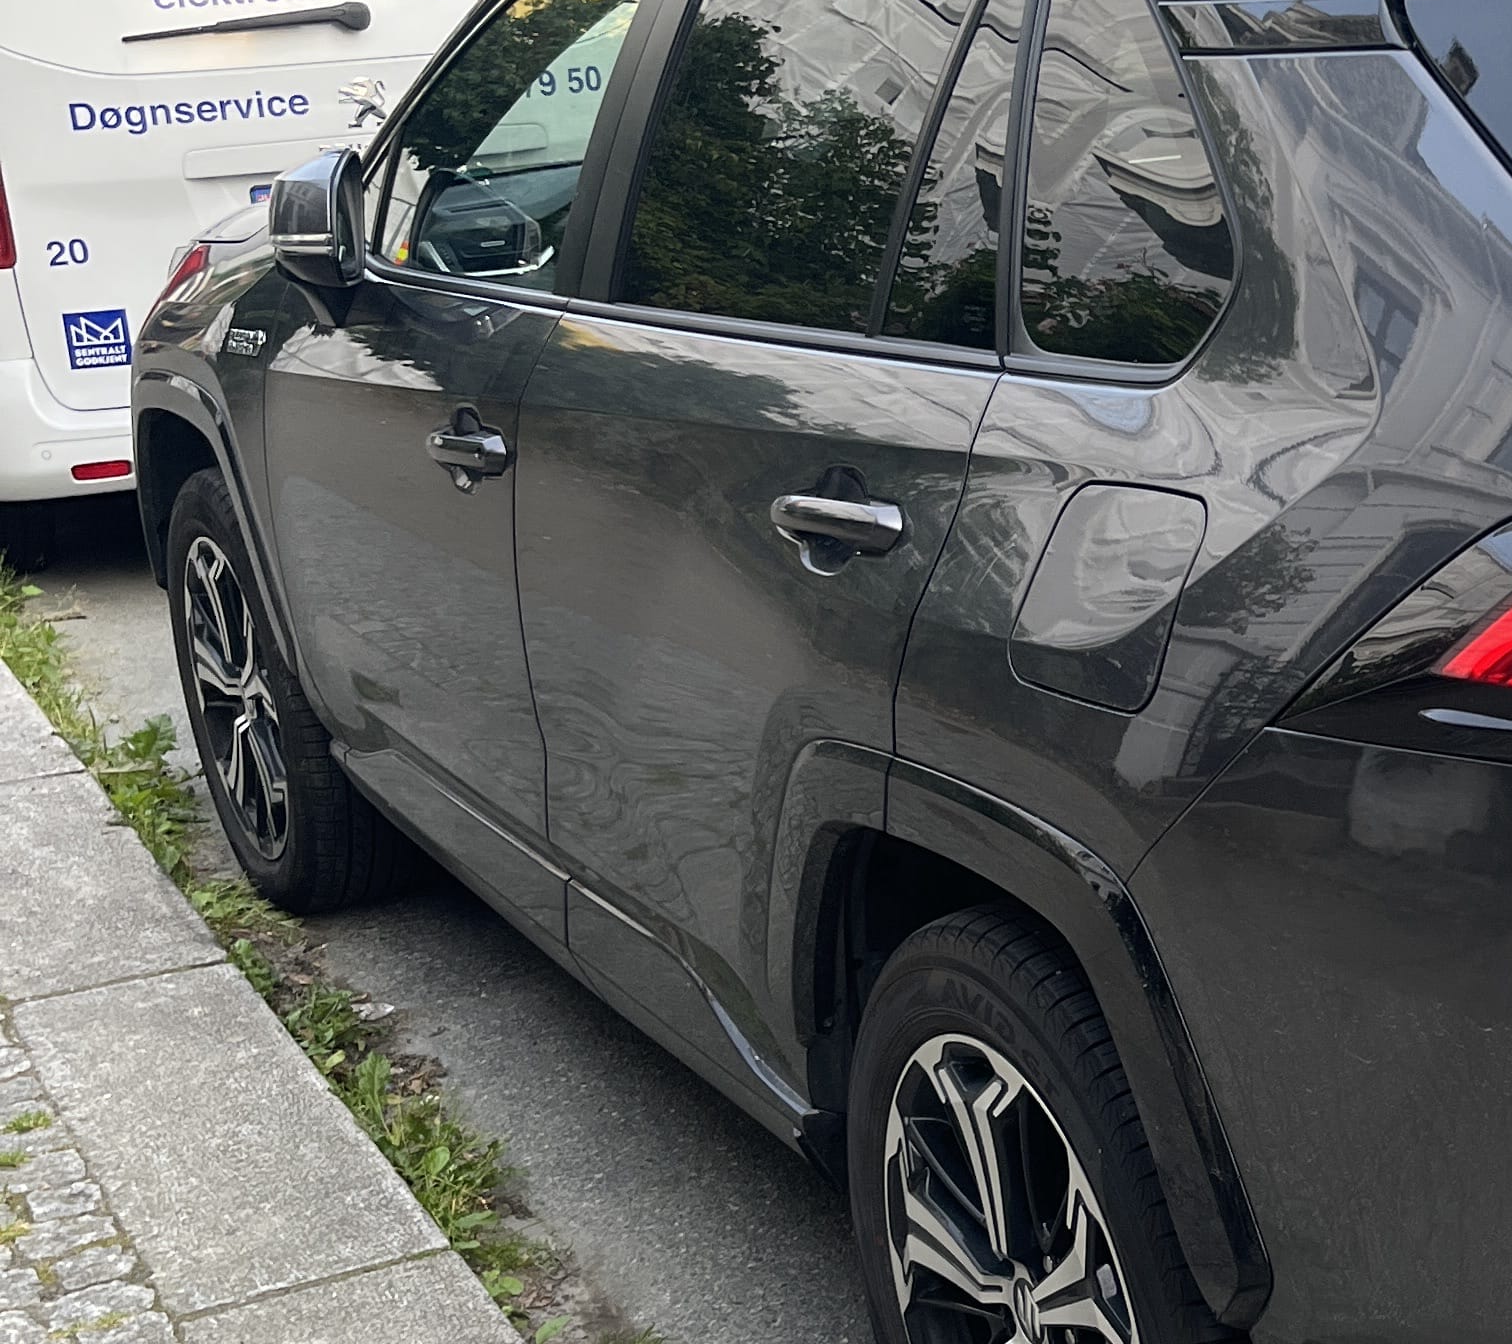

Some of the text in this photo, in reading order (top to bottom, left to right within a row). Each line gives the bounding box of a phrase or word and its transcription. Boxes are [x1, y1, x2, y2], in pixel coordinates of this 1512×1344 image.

[567, 65, 602, 94] 50
[68, 90, 310, 136] Døgnservice
[46, 238, 89, 267] 20
[75, 353, 128, 367] GODKJENT
